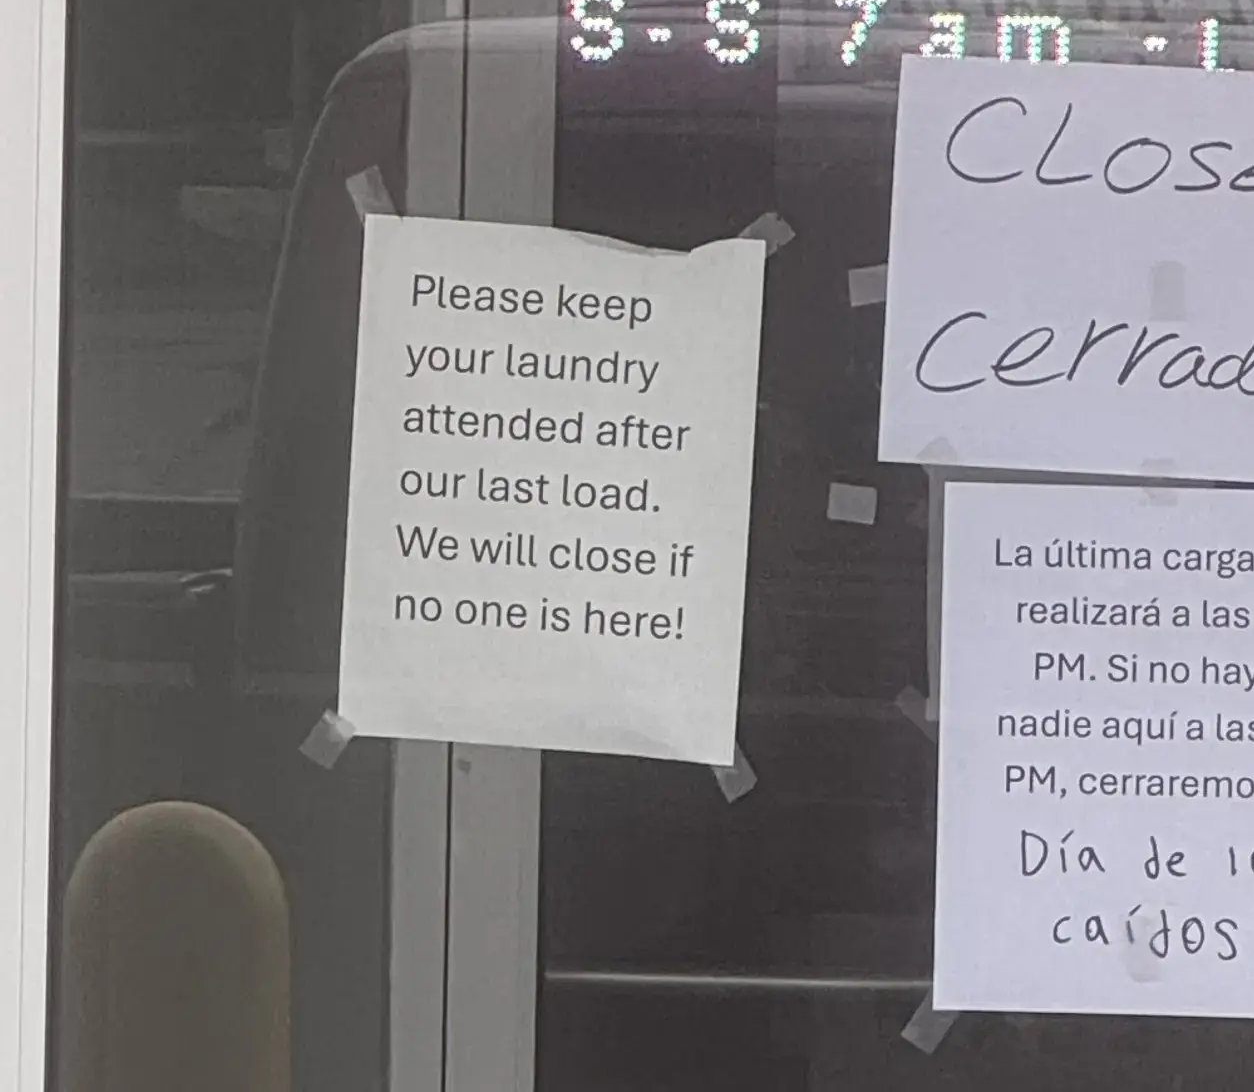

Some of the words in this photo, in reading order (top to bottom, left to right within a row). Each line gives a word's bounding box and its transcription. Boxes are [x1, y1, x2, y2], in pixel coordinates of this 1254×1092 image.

[412, 274, 543, 315] Please
[557, 284, 651, 330] keep
[405, 344, 495, 378] your
[506, 344, 659, 393] laundry
[403, 404, 583, 444] attended
[596, 415, 691, 451] after
[400, 470, 466, 499] our
[478, 468, 550, 505] last
[562, 474, 660, 512] load.
[396, 524, 458, 561] We
[470, 532, 537, 568] will
[549, 538, 656, 575] close
[670, 543, 694, 578] if
[996, 538, 1032, 567] La
[1045, 538, 1151, 570] última
[1163, 548, 1254, 579] carga
[395, 594, 442, 622] no
[455, 600, 527, 629] one
[541, 597, 570, 632] is
[584, 601, 683, 640] here!
[1017, 596, 1160, 627] realizará
[1172, 606, 1190, 627] a
[1203, 600, 1250, 629] las
[1035, 652, 1096, 681] PM.
[1108, 654, 1138, 683] Si
[1149, 662, 1190, 684] no
[998, 709, 1091, 738] nadie
[1102, 710, 1178, 746] aquí
[1186, 719, 1203, 741] a
[1006, 765, 1067, 799] PM,
[1021, 829, 1105, 876] Día
[1144, 836, 1187, 880] de
